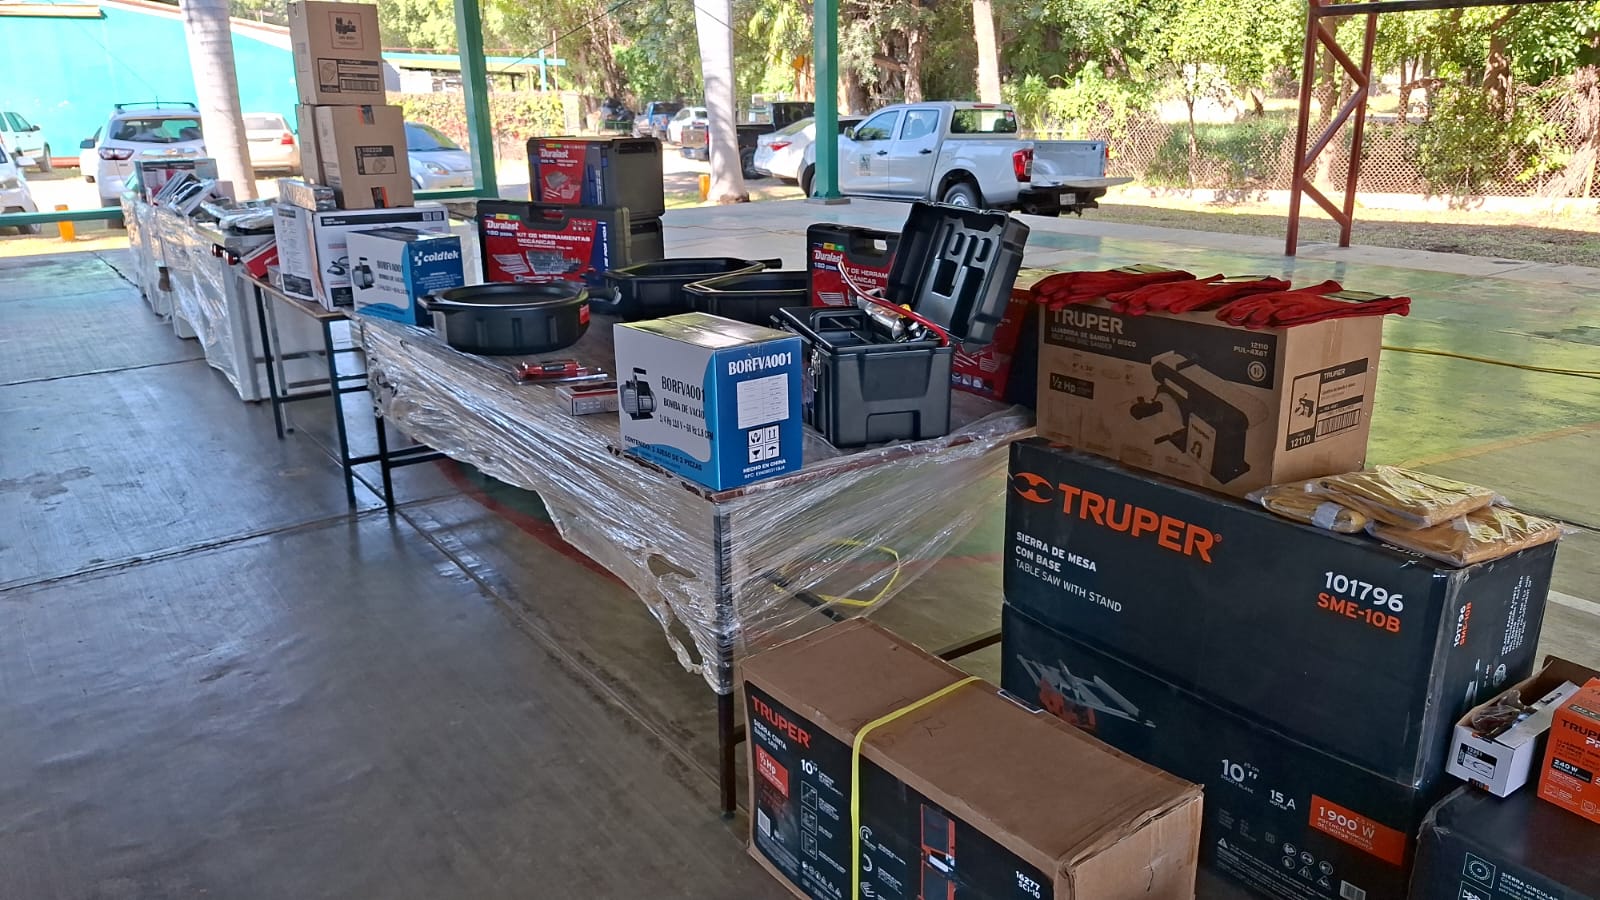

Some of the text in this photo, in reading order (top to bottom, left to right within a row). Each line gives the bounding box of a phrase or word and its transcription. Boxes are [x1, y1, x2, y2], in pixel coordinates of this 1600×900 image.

[485, 219, 519, 230] Duralast
[538, 233, 591, 242] HERRAMIENTAS
[423, 250, 459, 263] coldtek
[1117, 339, 1137, 348] DISCO
[728, 352, 792, 376] BORFVA001
[661, 375, 705, 402] BORFVA001
[663, 397, 680, 411] BOMBA
[681, 403, 688, 413] DE
[1290, 435, 1311, 448] 12110
[743, 464, 761, 474] HECHO
[770, 459, 786, 467] CHINA
[1015, 545, 1062, 572] CON BASE
[1016, 531, 1097, 572] SIERRA DE MESA
[1015, 558, 1122, 612] TABLE SAW WITH STAND
[1324, 571, 1404, 612] 101796
[1316, 592, 1401, 633] SME-10B
[752, 695, 810, 749] TRUPER
[1561, 718, 1600, 742] TRUP
[753, 718, 787, 751] SIERRA CINTA
[1553, 758, 1571, 770] 240
[1270, 789, 1296, 811] 15 A
[1362, 825, 1375, 840] W
[1016, 870, 1041, 891] 16277
[1501, 872, 1525, 887] SIERRA
